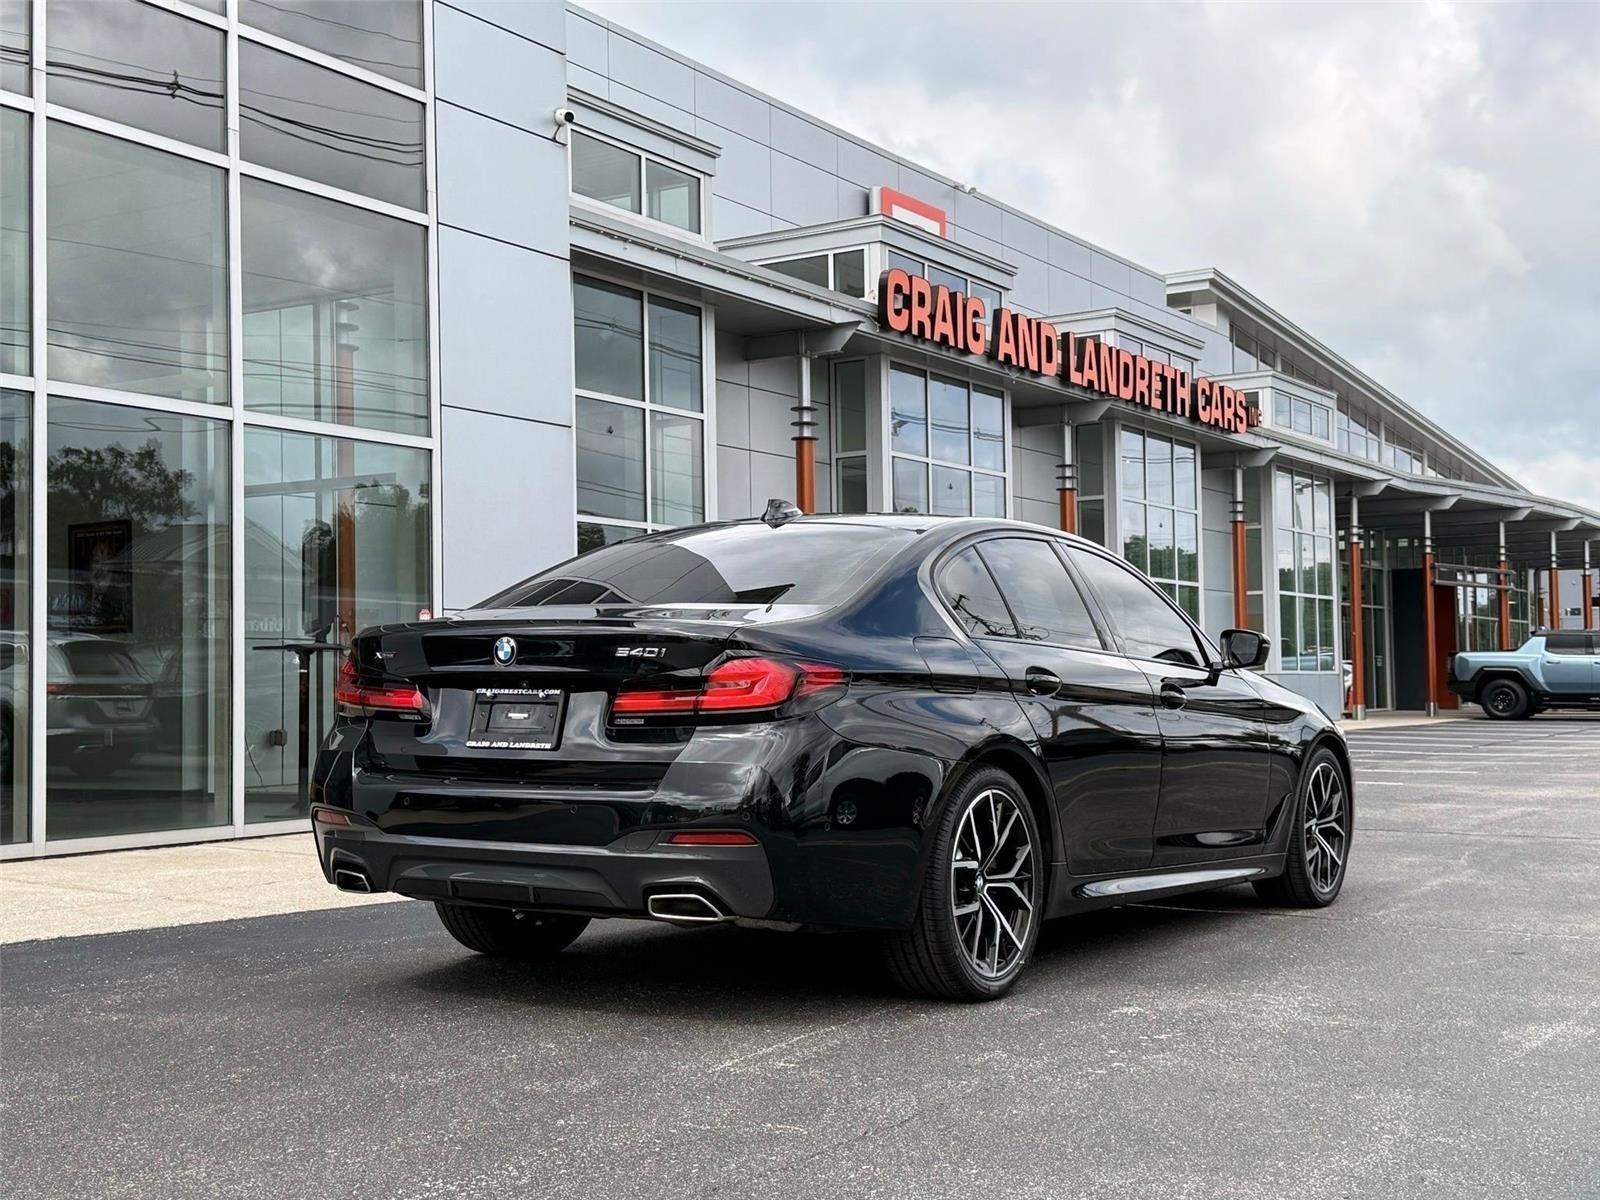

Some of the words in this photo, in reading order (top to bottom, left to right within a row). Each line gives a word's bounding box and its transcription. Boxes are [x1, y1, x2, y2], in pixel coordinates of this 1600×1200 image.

[884, 268, 986, 355] CRAIG
[997, 308, 1058, 377] AND
[1067, 332, 1190, 417] LANDRETH
[1195, 377, 1247, 433] CARS
